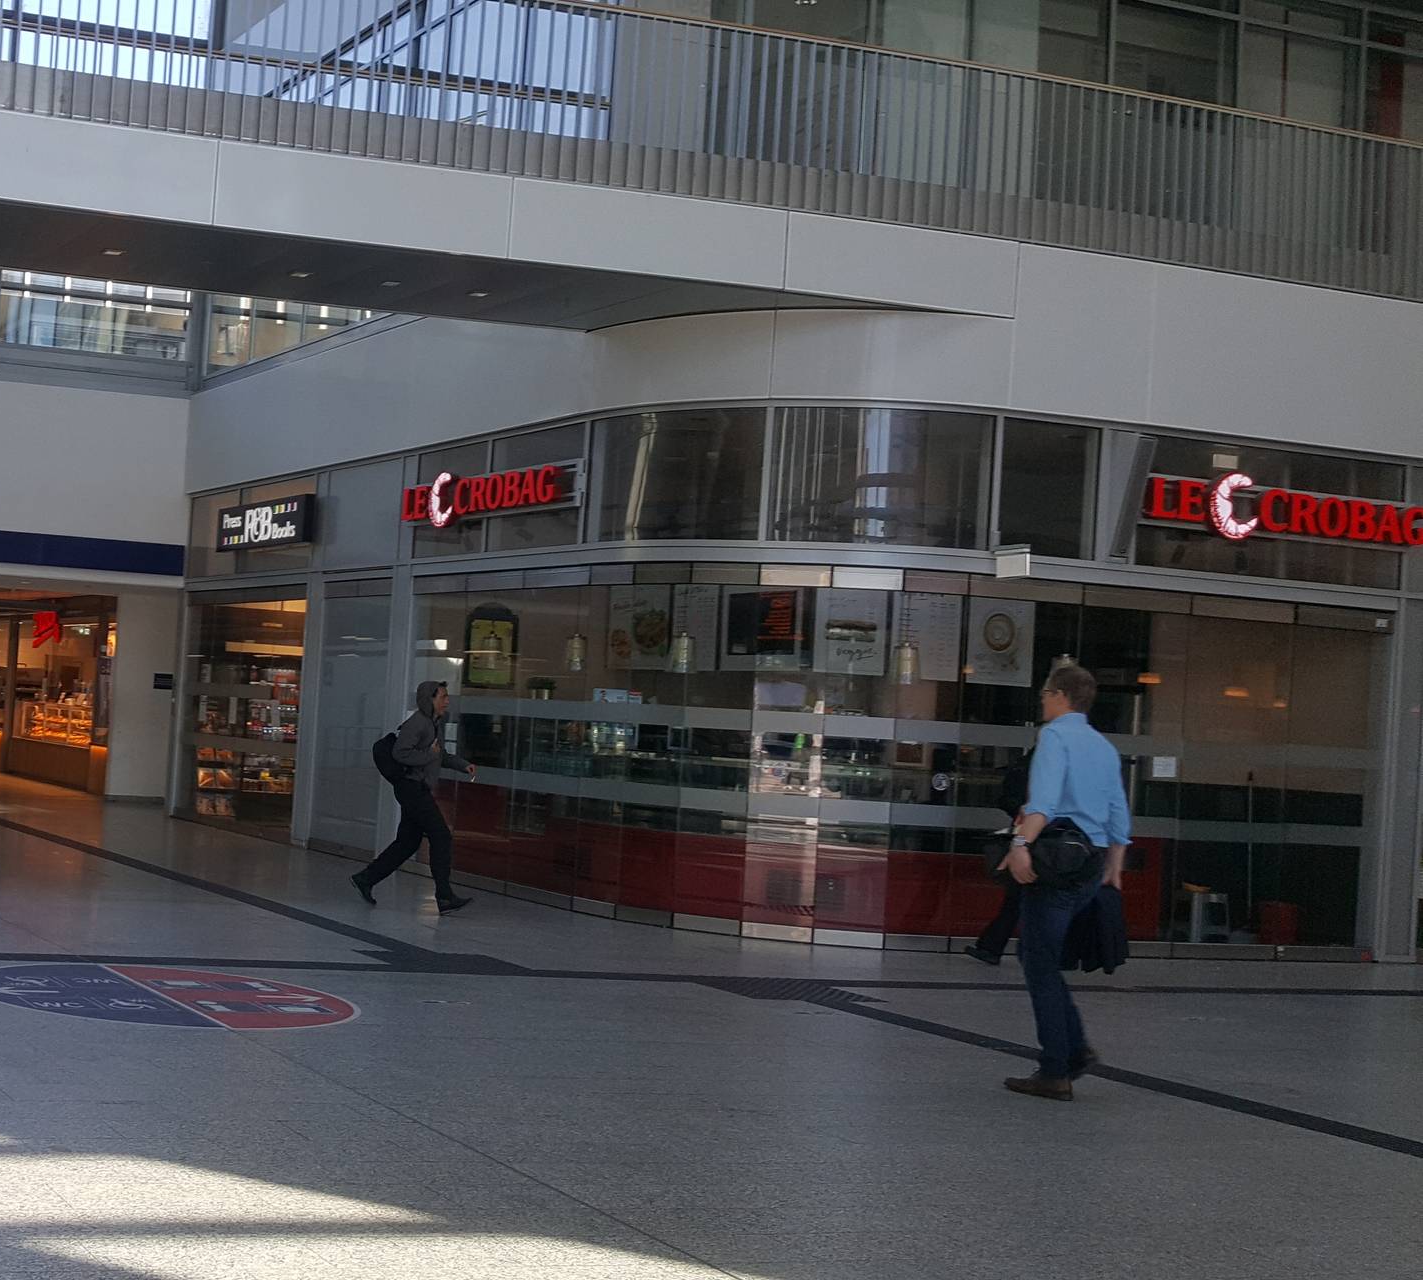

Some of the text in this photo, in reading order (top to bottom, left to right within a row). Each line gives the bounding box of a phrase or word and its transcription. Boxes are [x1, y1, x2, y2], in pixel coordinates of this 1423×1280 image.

[401, 466, 556, 520] LE CROBAG
[1152, 477, 1208, 522] LE
[222, 513, 242, 529] Press
[272, 520, 296, 539] Books
